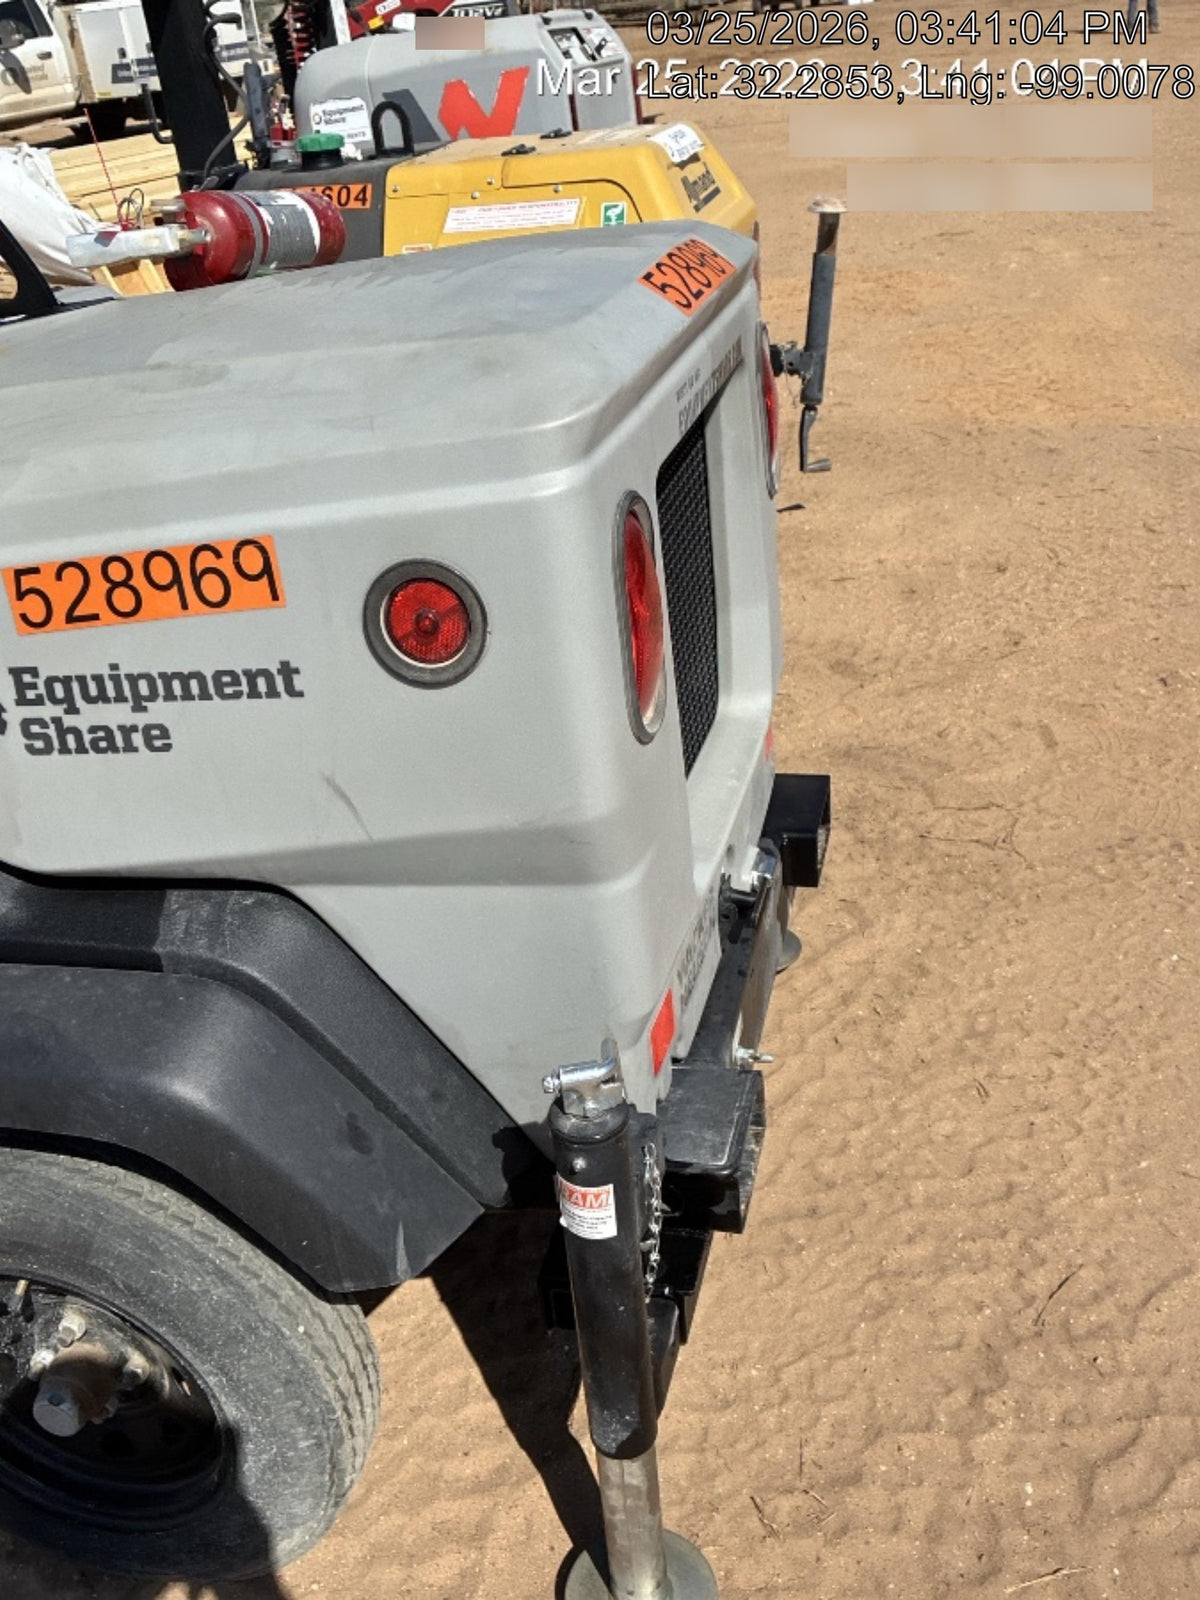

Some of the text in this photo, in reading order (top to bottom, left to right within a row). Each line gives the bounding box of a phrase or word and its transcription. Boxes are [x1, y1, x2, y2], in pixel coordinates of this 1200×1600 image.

[13, 538, 280, 629] 528969
[8, 660, 305, 715] Equipment
[19, 716, 173, 756] Share
